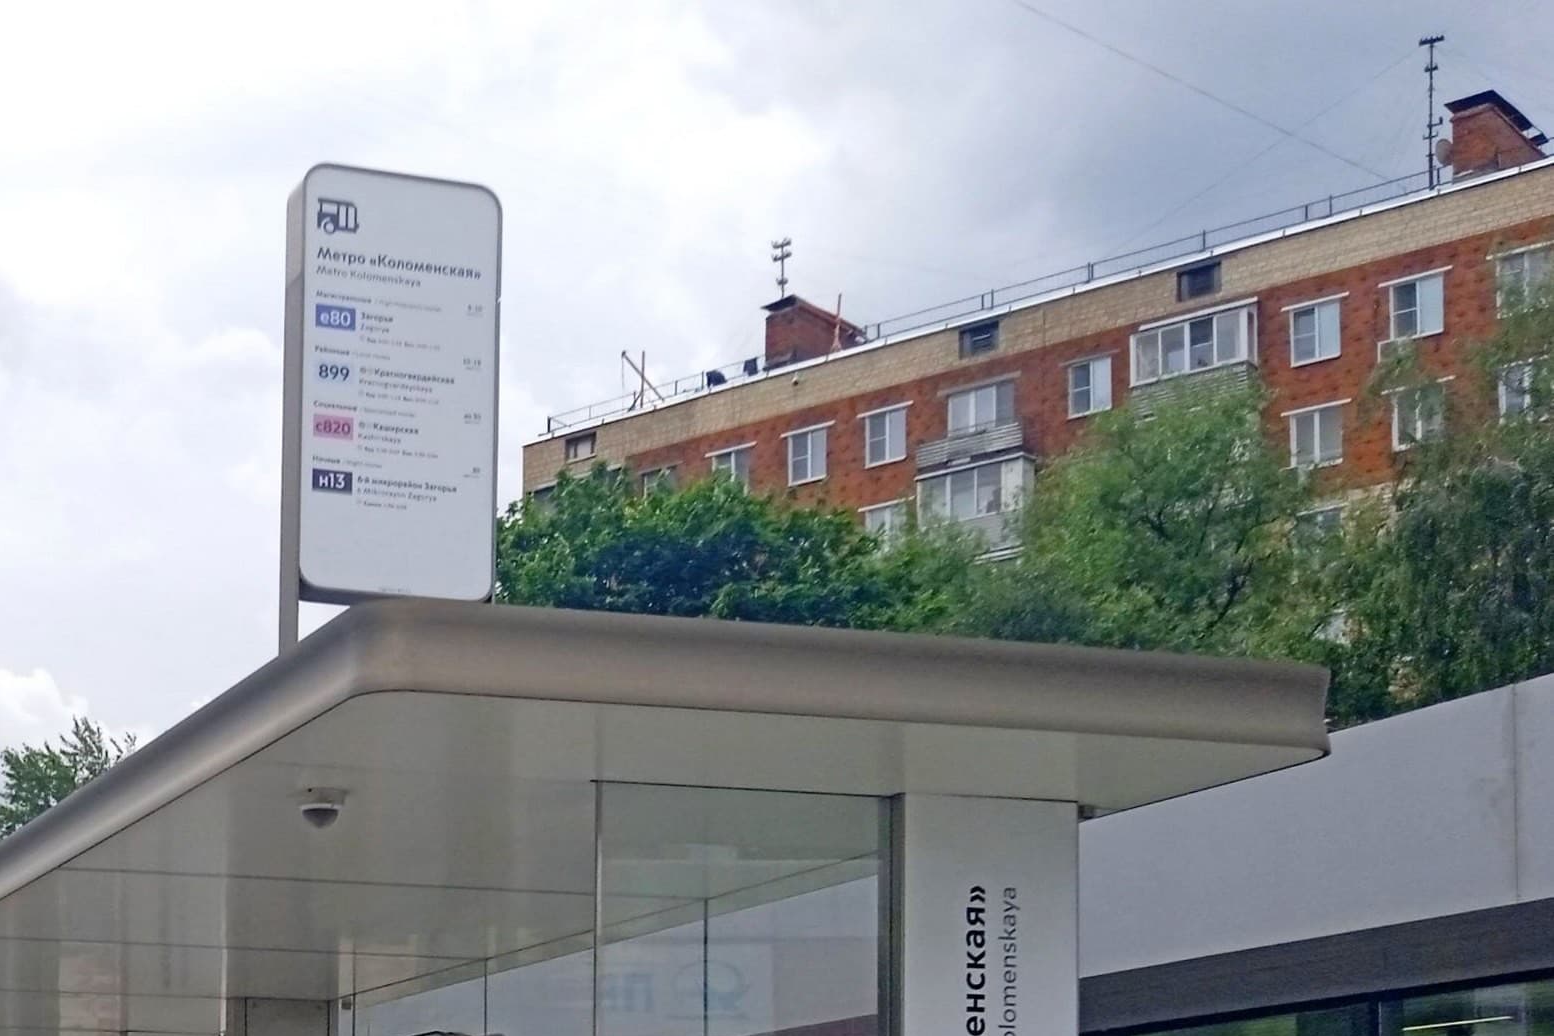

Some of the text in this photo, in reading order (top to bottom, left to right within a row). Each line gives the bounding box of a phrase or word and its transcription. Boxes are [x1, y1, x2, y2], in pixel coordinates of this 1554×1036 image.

[317, 247, 482, 281] Метро «Коломенская»
[316, 265, 421, 288] Metro Kolomenskaya
[318, 363, 350, 382] 899
[318, 472, 346, 489] н13
